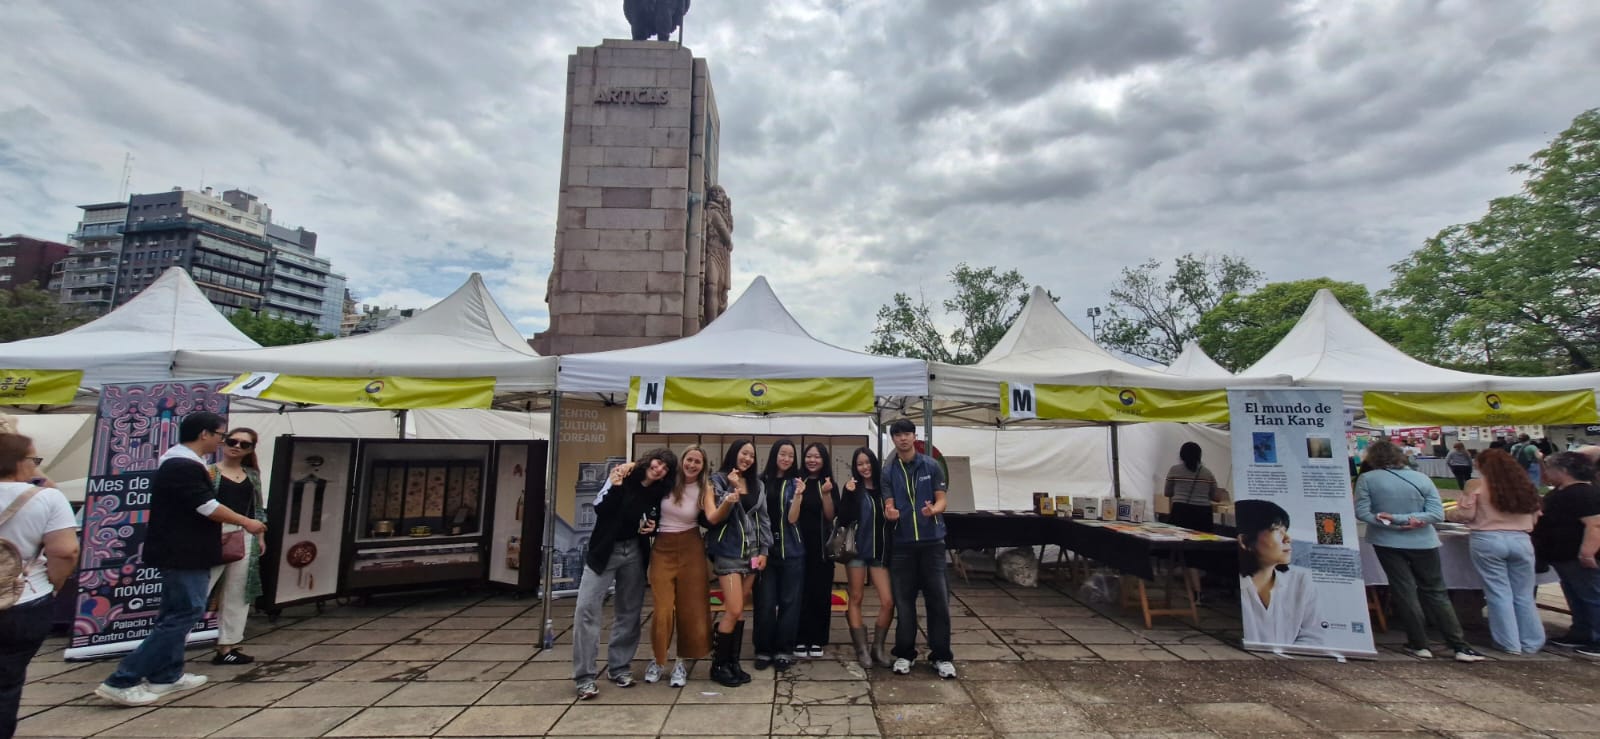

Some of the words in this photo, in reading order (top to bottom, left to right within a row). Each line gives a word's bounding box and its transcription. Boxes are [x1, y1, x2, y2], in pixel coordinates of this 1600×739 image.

[645, 382, 659, 405] N
[1013, 389, 1031, 411] M
[1245, 403, 1258, 414] El
[1262, 403, 1312, 414] mundo
[1315, 403, 1332, 414] de
[1254, 414, 1285, 426] Han
[1287, 414, 1325, 428] Kang
[89, 478, 124, 493] Mes
[129, 476, 150, 490] de
[113, 618, 147, 629] Palacio
[91, 631, 124, 643] Centro
